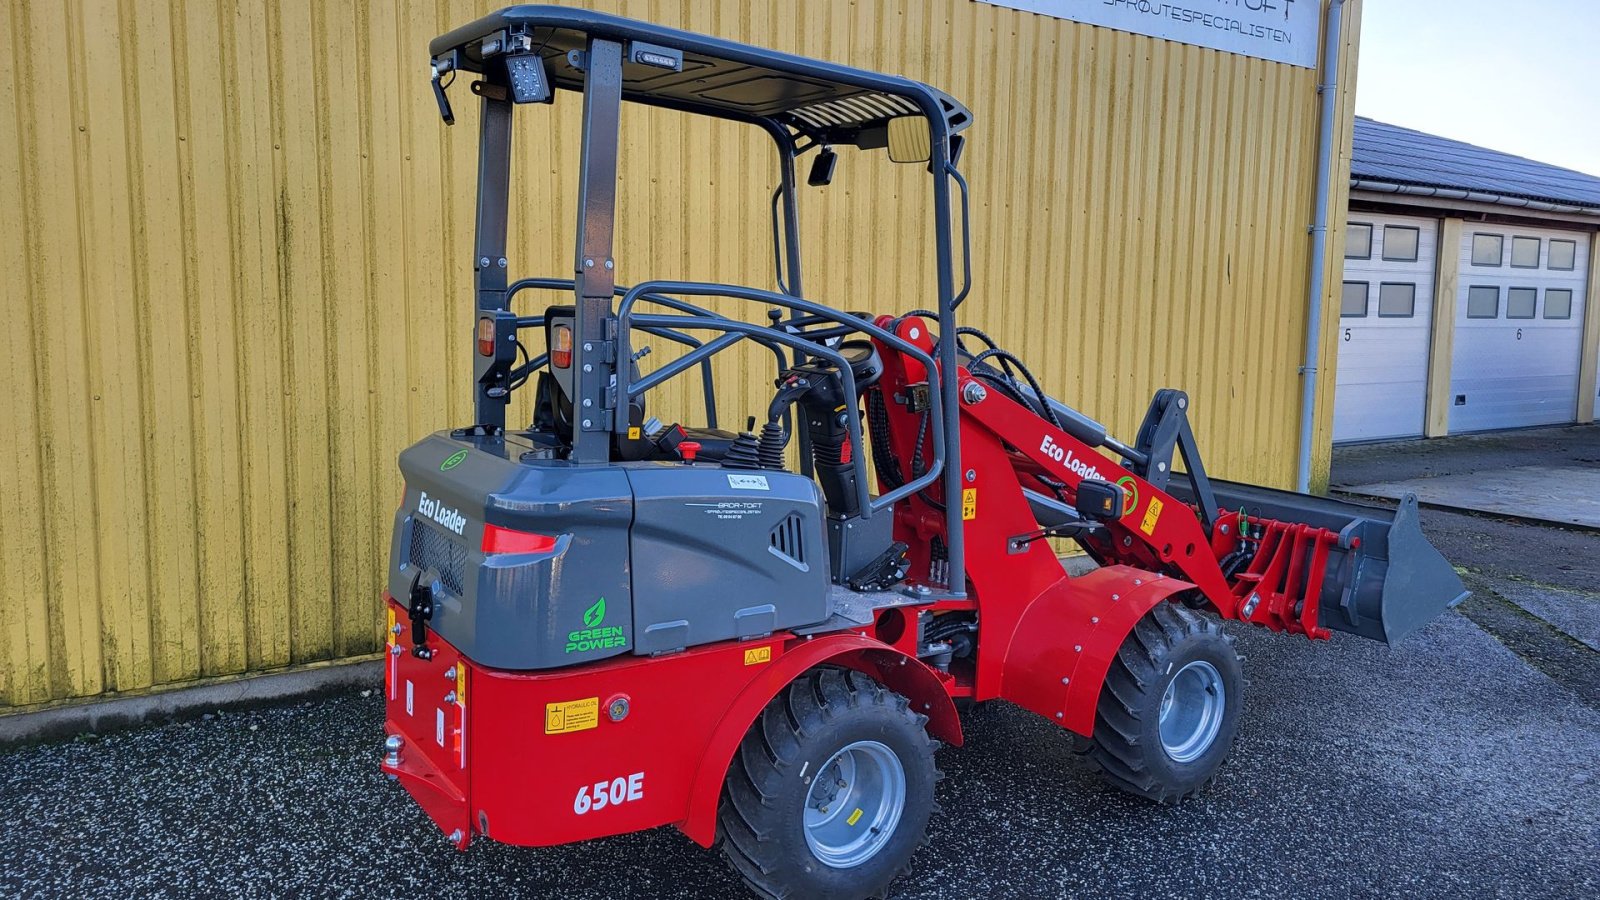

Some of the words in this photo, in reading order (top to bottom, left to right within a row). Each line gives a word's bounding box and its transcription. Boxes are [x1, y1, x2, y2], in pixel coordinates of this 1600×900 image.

[1344, 328, 1351, 342] 5
[1516, 328, 1523, 341] 6
[1040, 434, 1064, 462] Eco
[418, 491, 435, 519] Eco
[433, 500, 467, 536] Loader
[568, 625, 623, 641] GREEN
[565, 636, 626, 653] POWER
[573, 771, 645, 815] 650E
